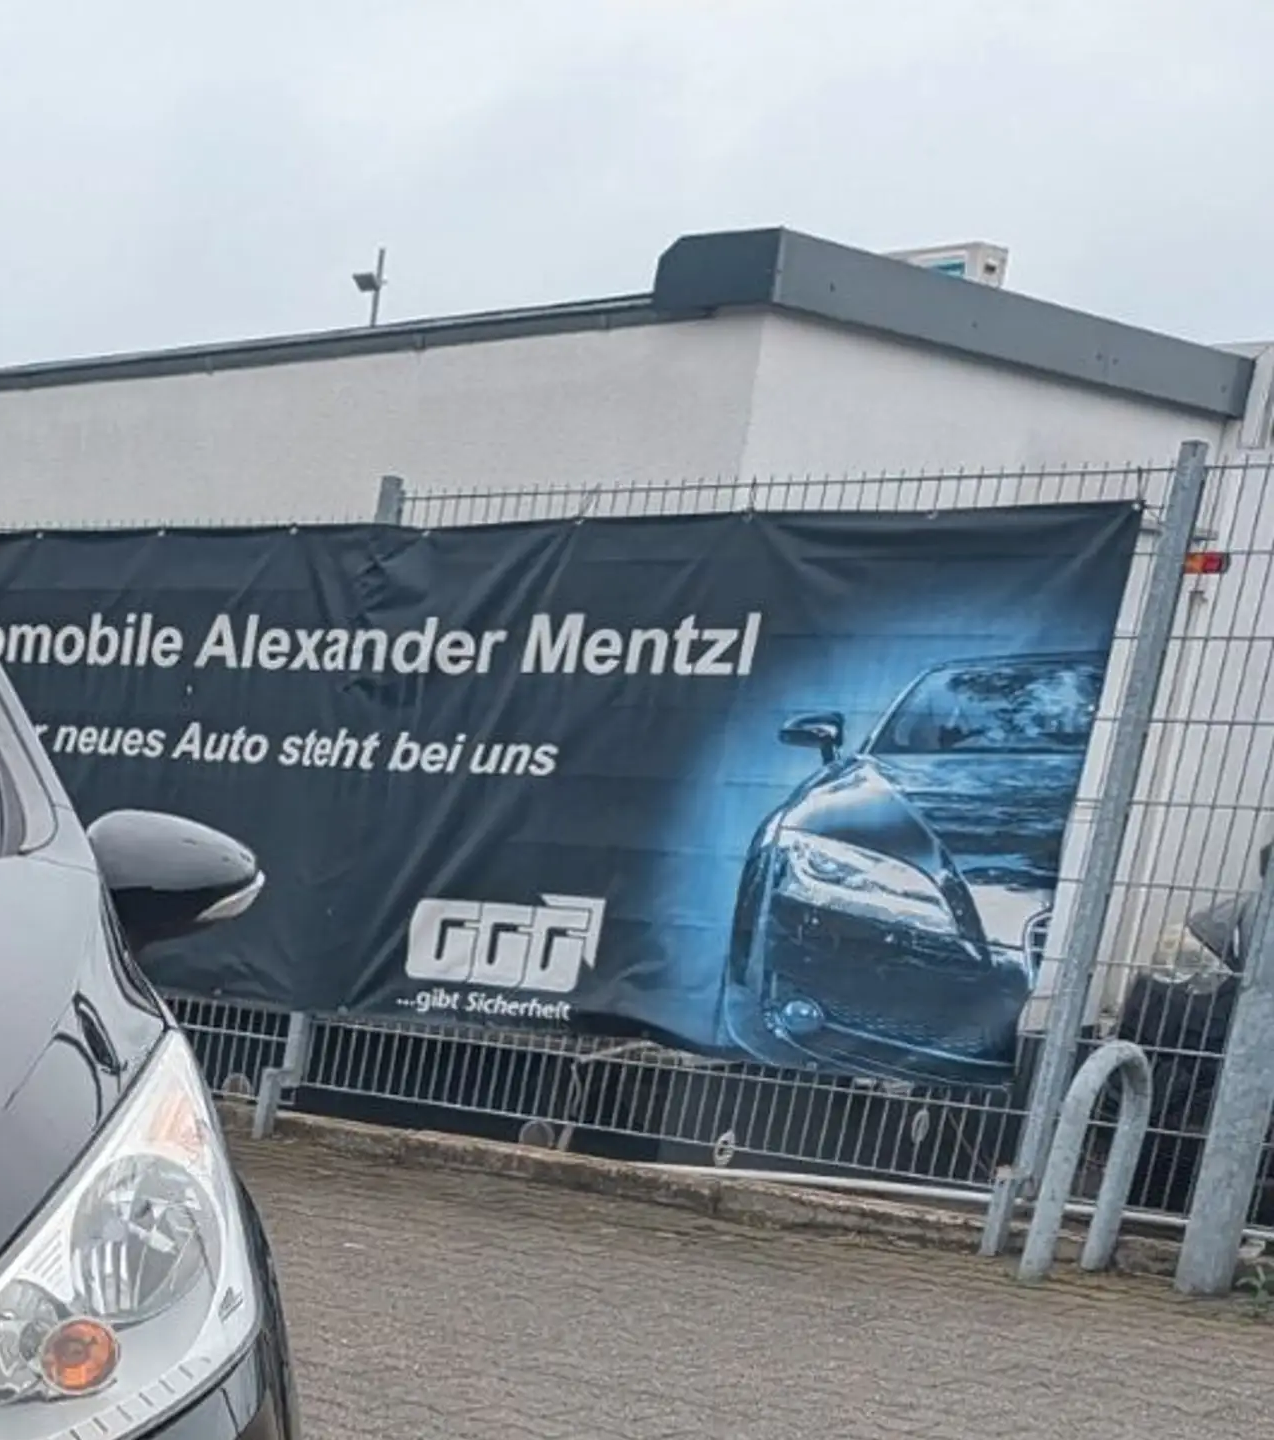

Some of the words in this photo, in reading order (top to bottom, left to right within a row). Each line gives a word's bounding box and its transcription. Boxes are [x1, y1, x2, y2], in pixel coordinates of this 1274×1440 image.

[194, 613, 508, 675] Alexander
[520, 612, 763, 676] Mentzl
[53, 724, 167, 758] neues
[172, 721, 270, 764] Auto
[278, 728, 380, 771] steht
[388, 731, 466, 773] bei
[469, 740, 560, 777] uns
[465, 991, 573, 1021] Sicherheit
